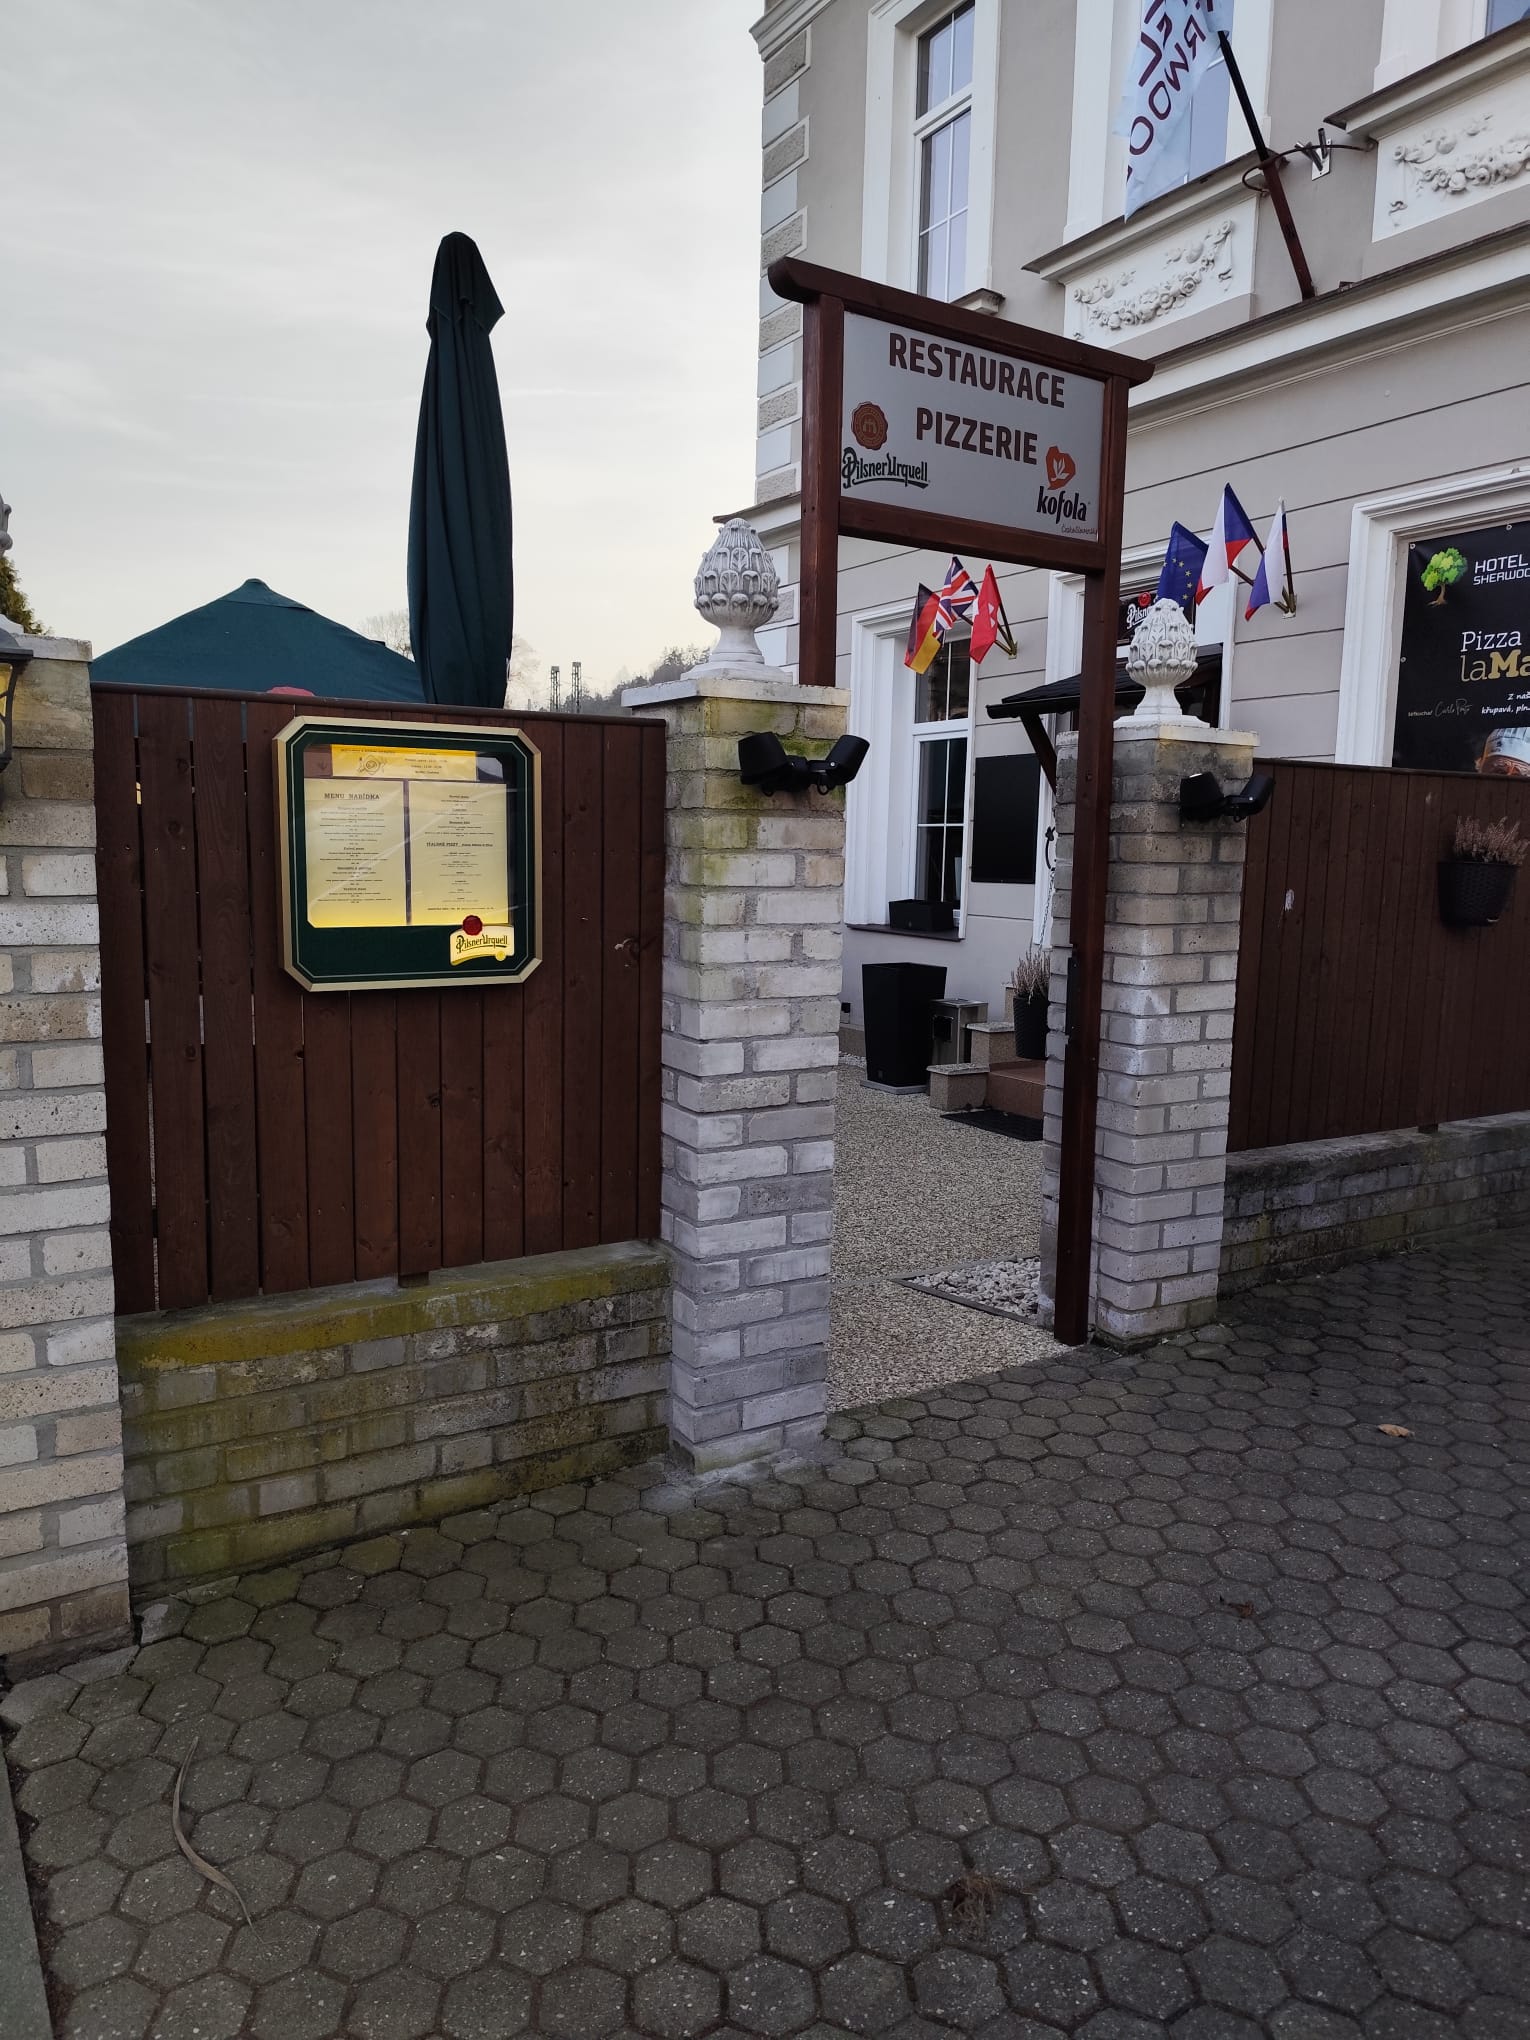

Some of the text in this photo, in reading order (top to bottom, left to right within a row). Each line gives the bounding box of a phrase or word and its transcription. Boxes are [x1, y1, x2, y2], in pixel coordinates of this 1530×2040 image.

[889, 332, 1065, 409] RESTAURACE
[916, 407, 1038, 465] PIZZERIE
[842, 447, 928, 489] Pilsner Urquell
[1036, 485, 1087, 525] kofola
[1474, 553, 1529, 574] HOTEL
[1460, 630, 1523, 652] Pizza
[348, 792, 380, 800] NABÍDKA
[456, 933, 508, 954] Pilsner Urquell
